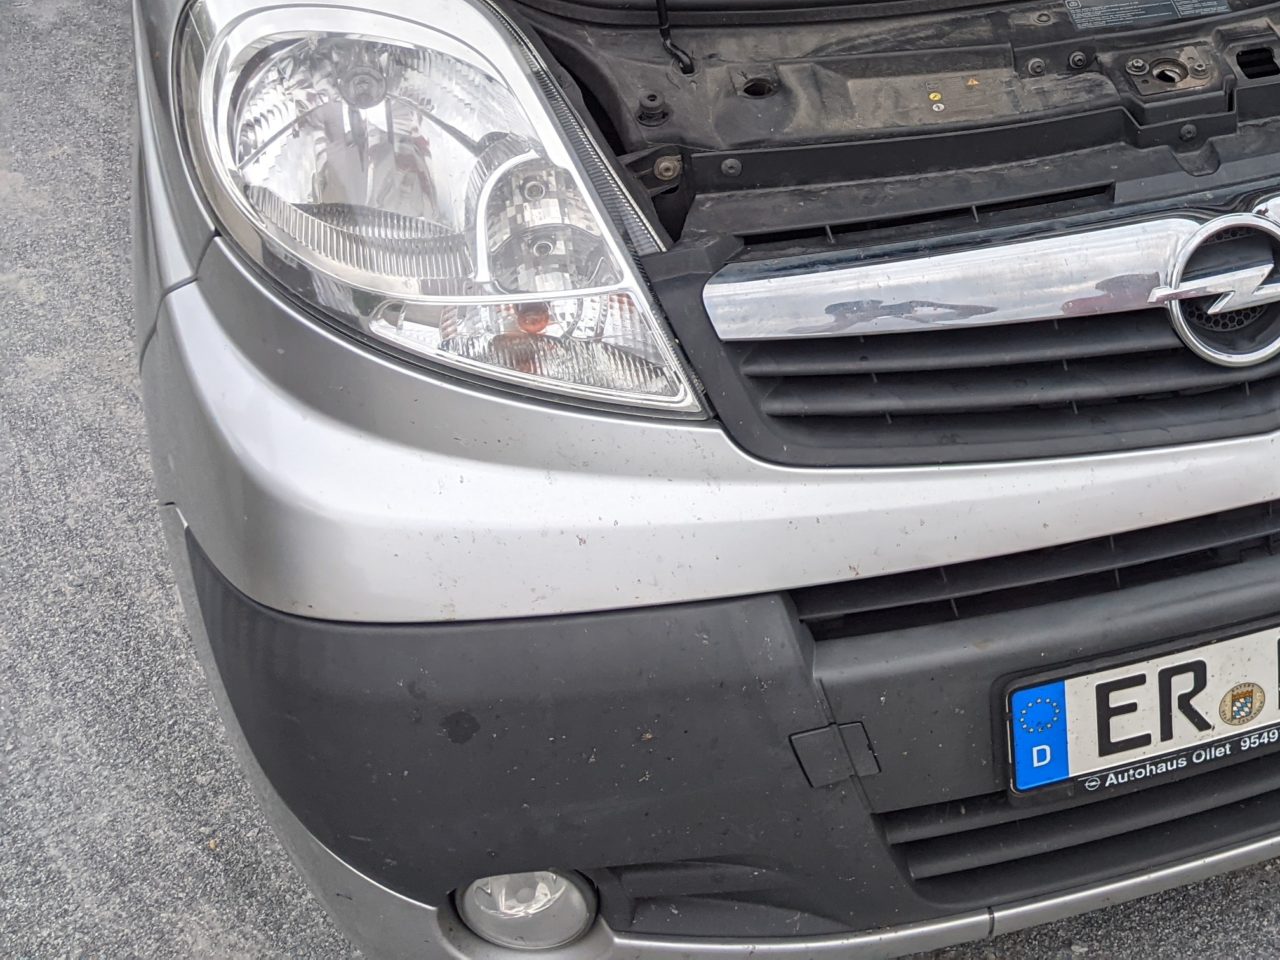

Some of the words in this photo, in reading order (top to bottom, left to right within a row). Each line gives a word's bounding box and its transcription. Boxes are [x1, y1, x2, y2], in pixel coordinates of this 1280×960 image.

[1095, 659, 1215, 757] ER
[1031, 744, 1052, 768] D
[1105, 756, 1188, 787] Autohaus
